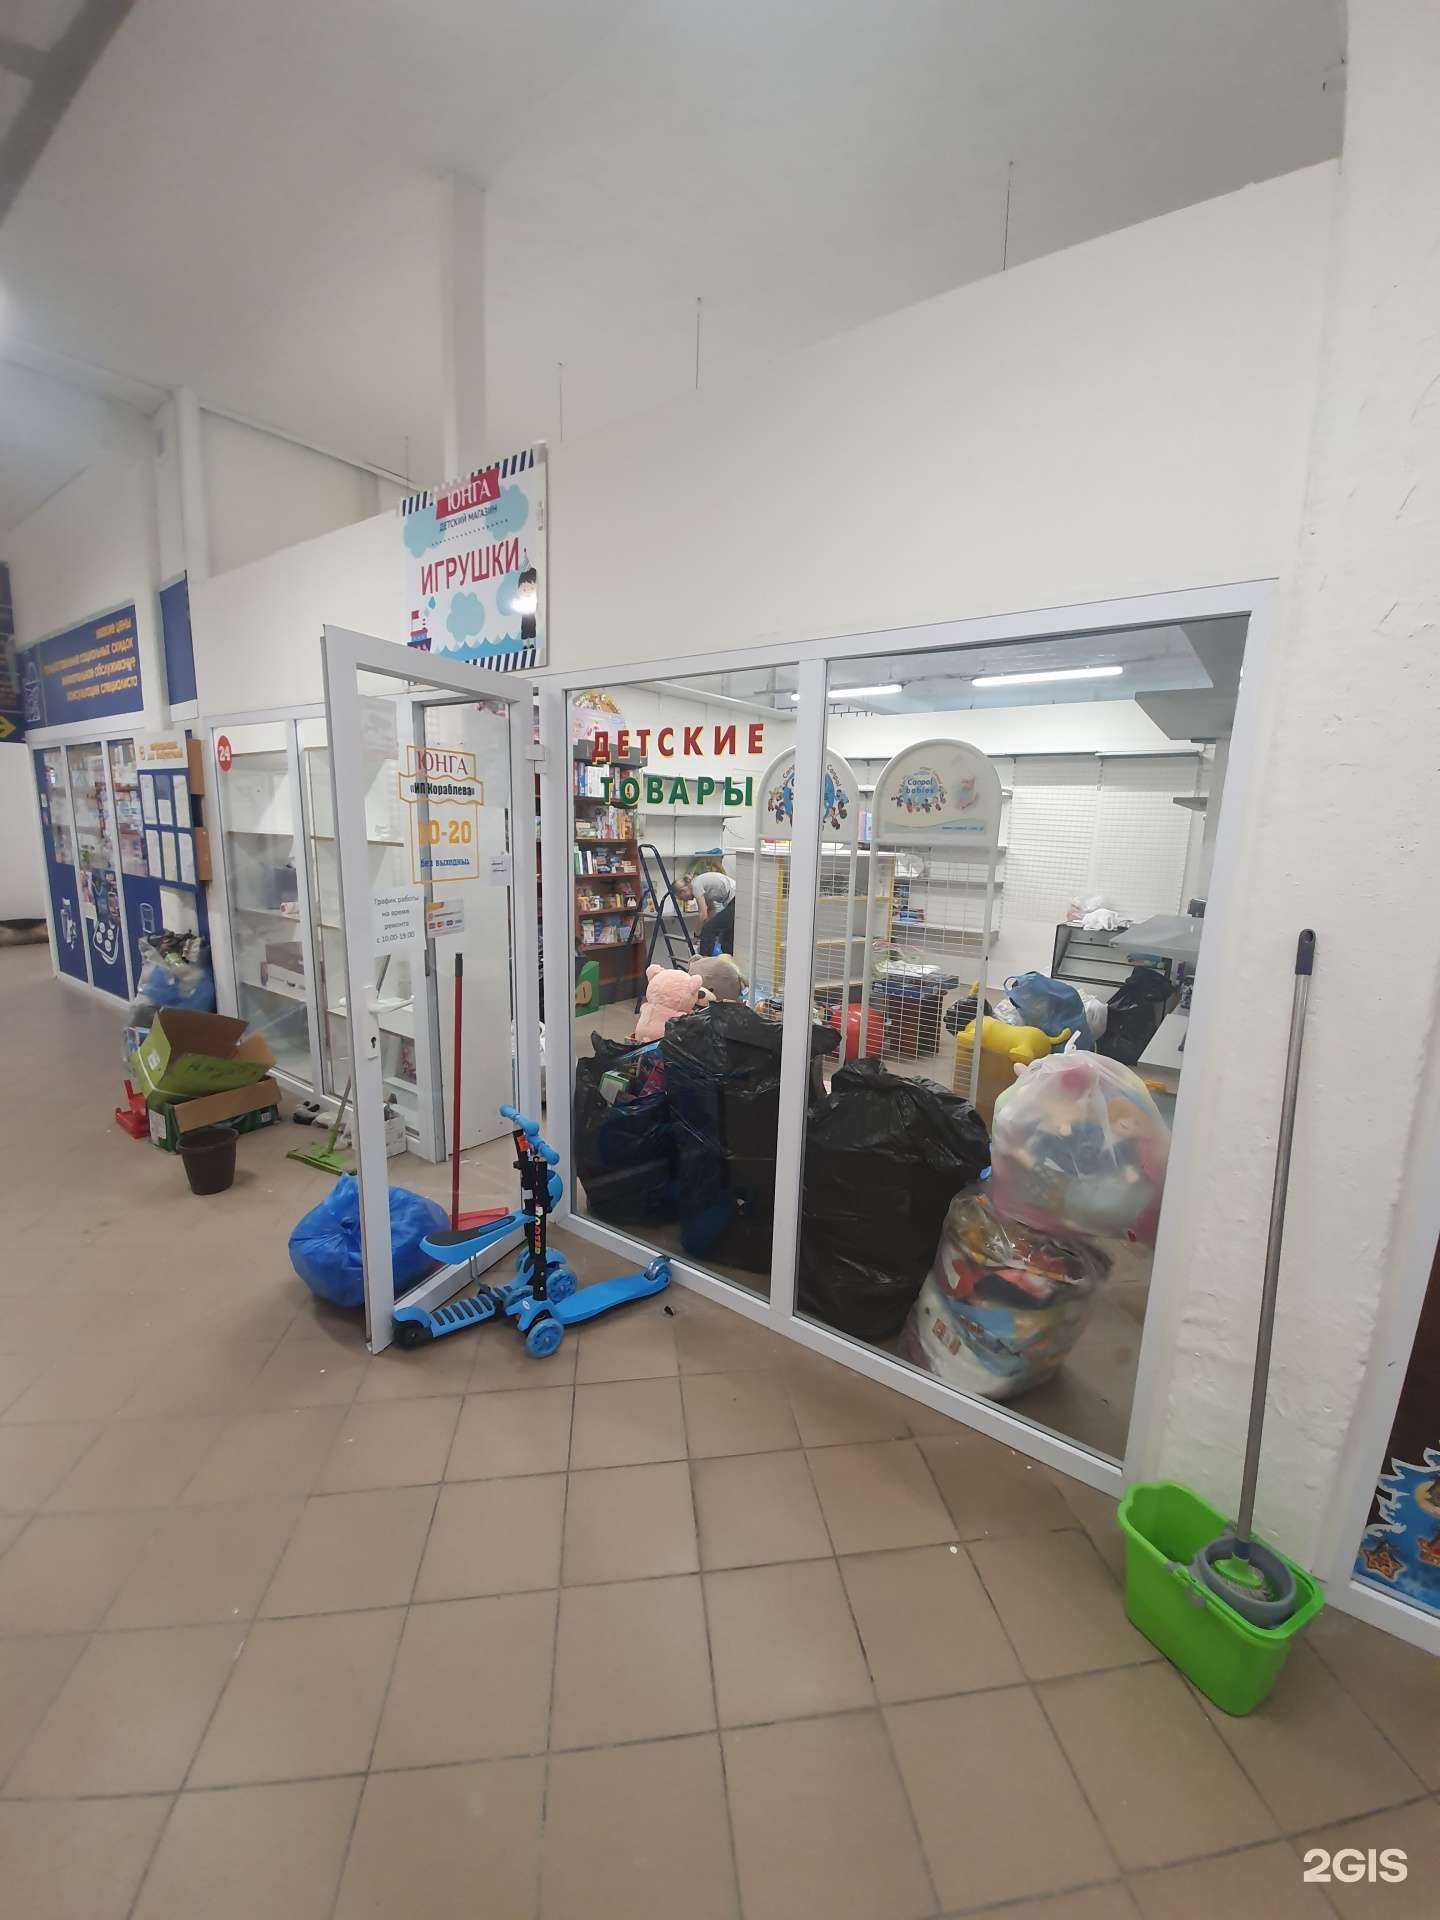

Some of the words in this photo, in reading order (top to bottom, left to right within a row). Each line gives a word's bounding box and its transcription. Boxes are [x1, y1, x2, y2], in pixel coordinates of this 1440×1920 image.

[447, 479, 492, 512] ЮНГА
[421, 537, 519, 596] ИГРУШКИ
[219, 746, 231, 761] 24
[591, 723, 764, 764] ДЕТСКИЕ
[417, 750, 468, 775] ЮНГА
[600, 776, 753, 807] ТОВАРЫ
